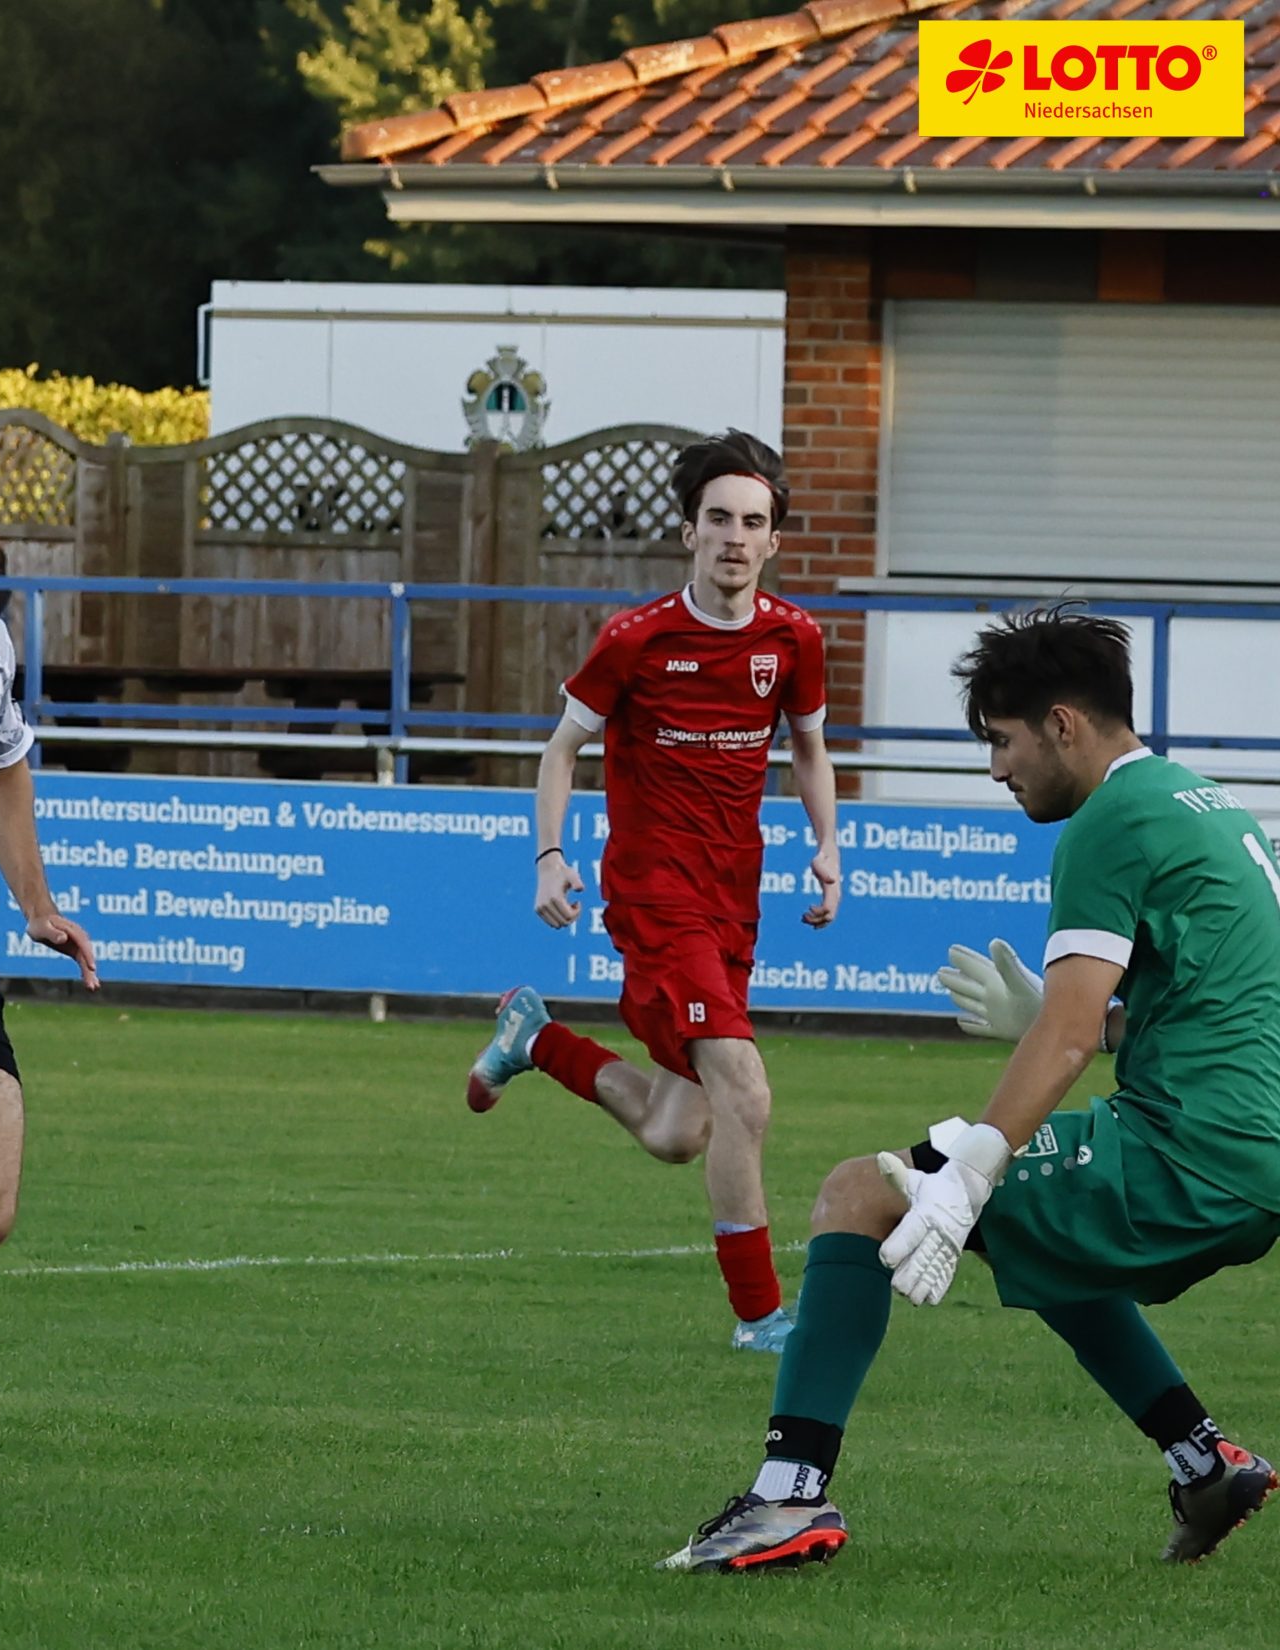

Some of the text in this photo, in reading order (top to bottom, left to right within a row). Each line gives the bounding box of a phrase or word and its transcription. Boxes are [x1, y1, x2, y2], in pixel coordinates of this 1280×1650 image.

[665, 660, 699, 672] JAKO
[657, 728, 706, 741] SOMMER
[33, 796, 531, 841] oruntersuchungen & Vorbemessungen
[863, 823, 1018, 859] Detailpläne
[39, 839, 324, 881] atische Berechnungen
[850, 869, 1051, 903] Stahlbetonferti
[97, 888, 148, 915] und
[154, 889, 390, 928] Bewehrungspläne
[835, 964, 952, 994] Nachwe
[688, 1002, 706, 1023] 19
